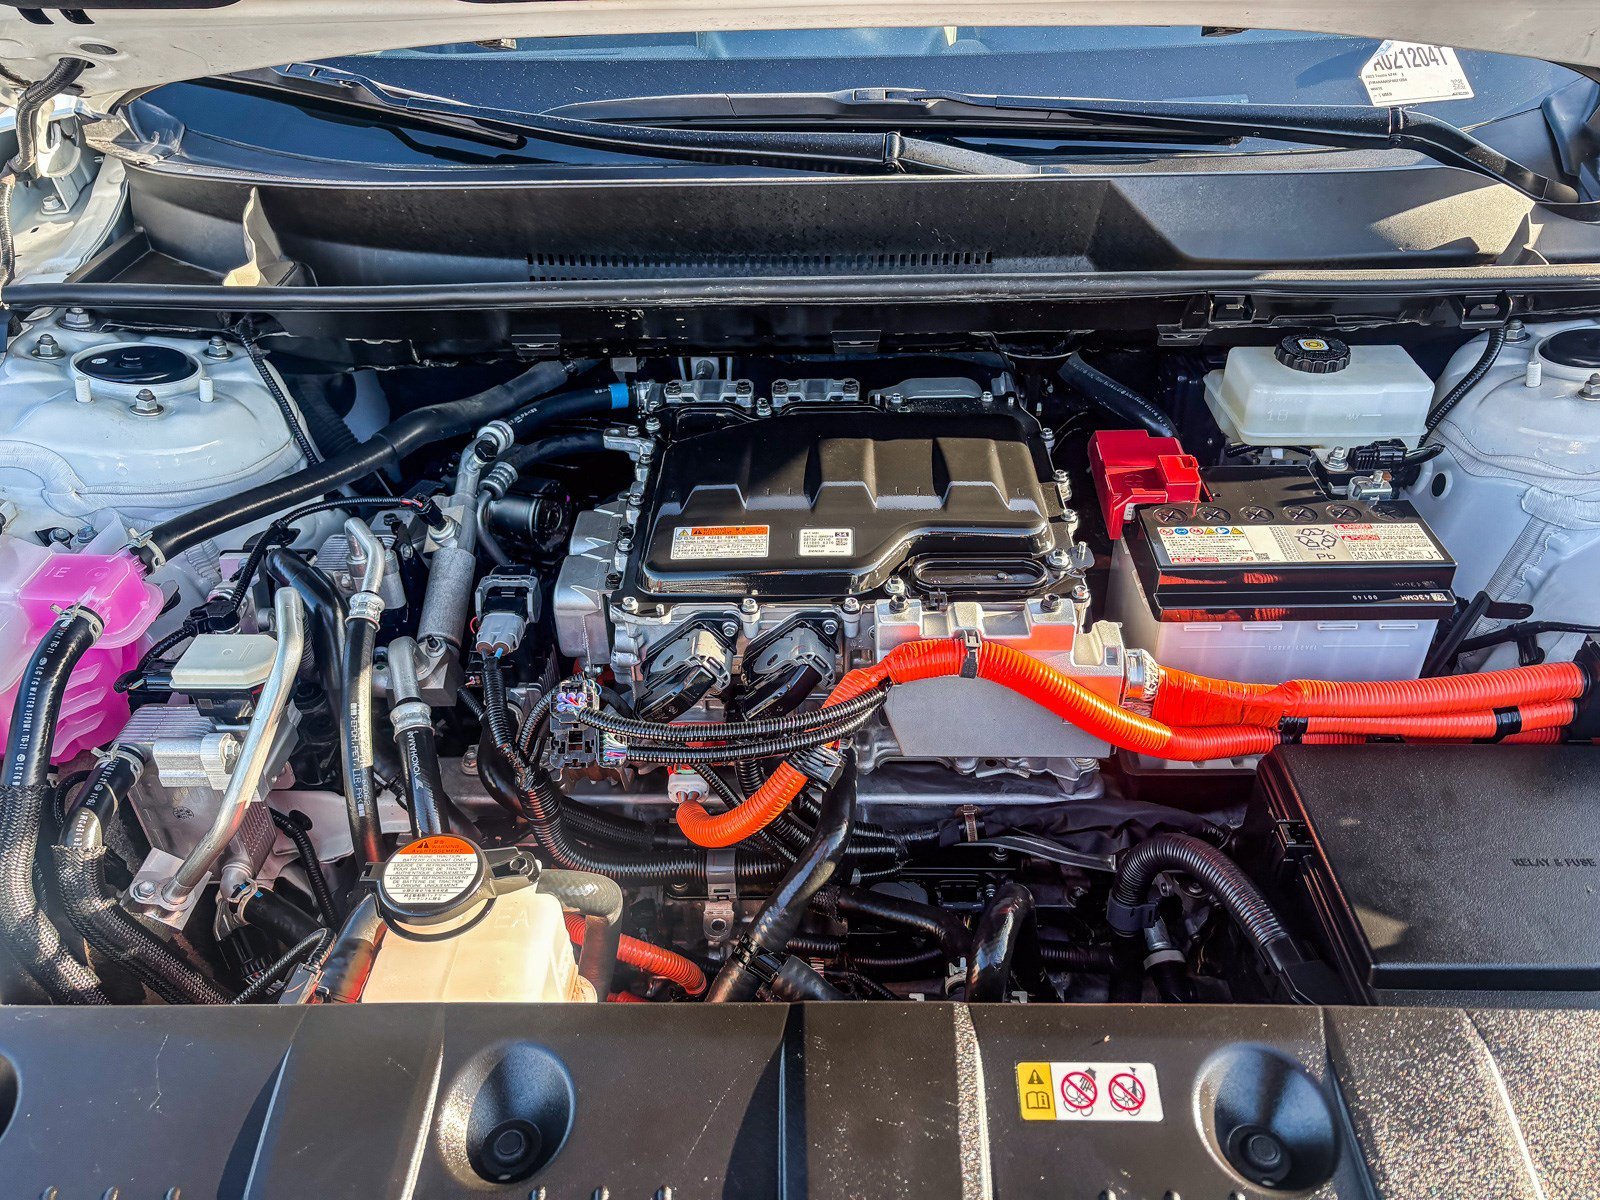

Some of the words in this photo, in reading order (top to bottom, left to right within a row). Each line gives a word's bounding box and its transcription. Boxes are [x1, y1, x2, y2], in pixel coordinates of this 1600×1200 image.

[407, 731, 421, 777] YOKOHAMA
[1511, 858, 1550, 867] RELAY
[1564, 858, 1597, 867] FUSE
